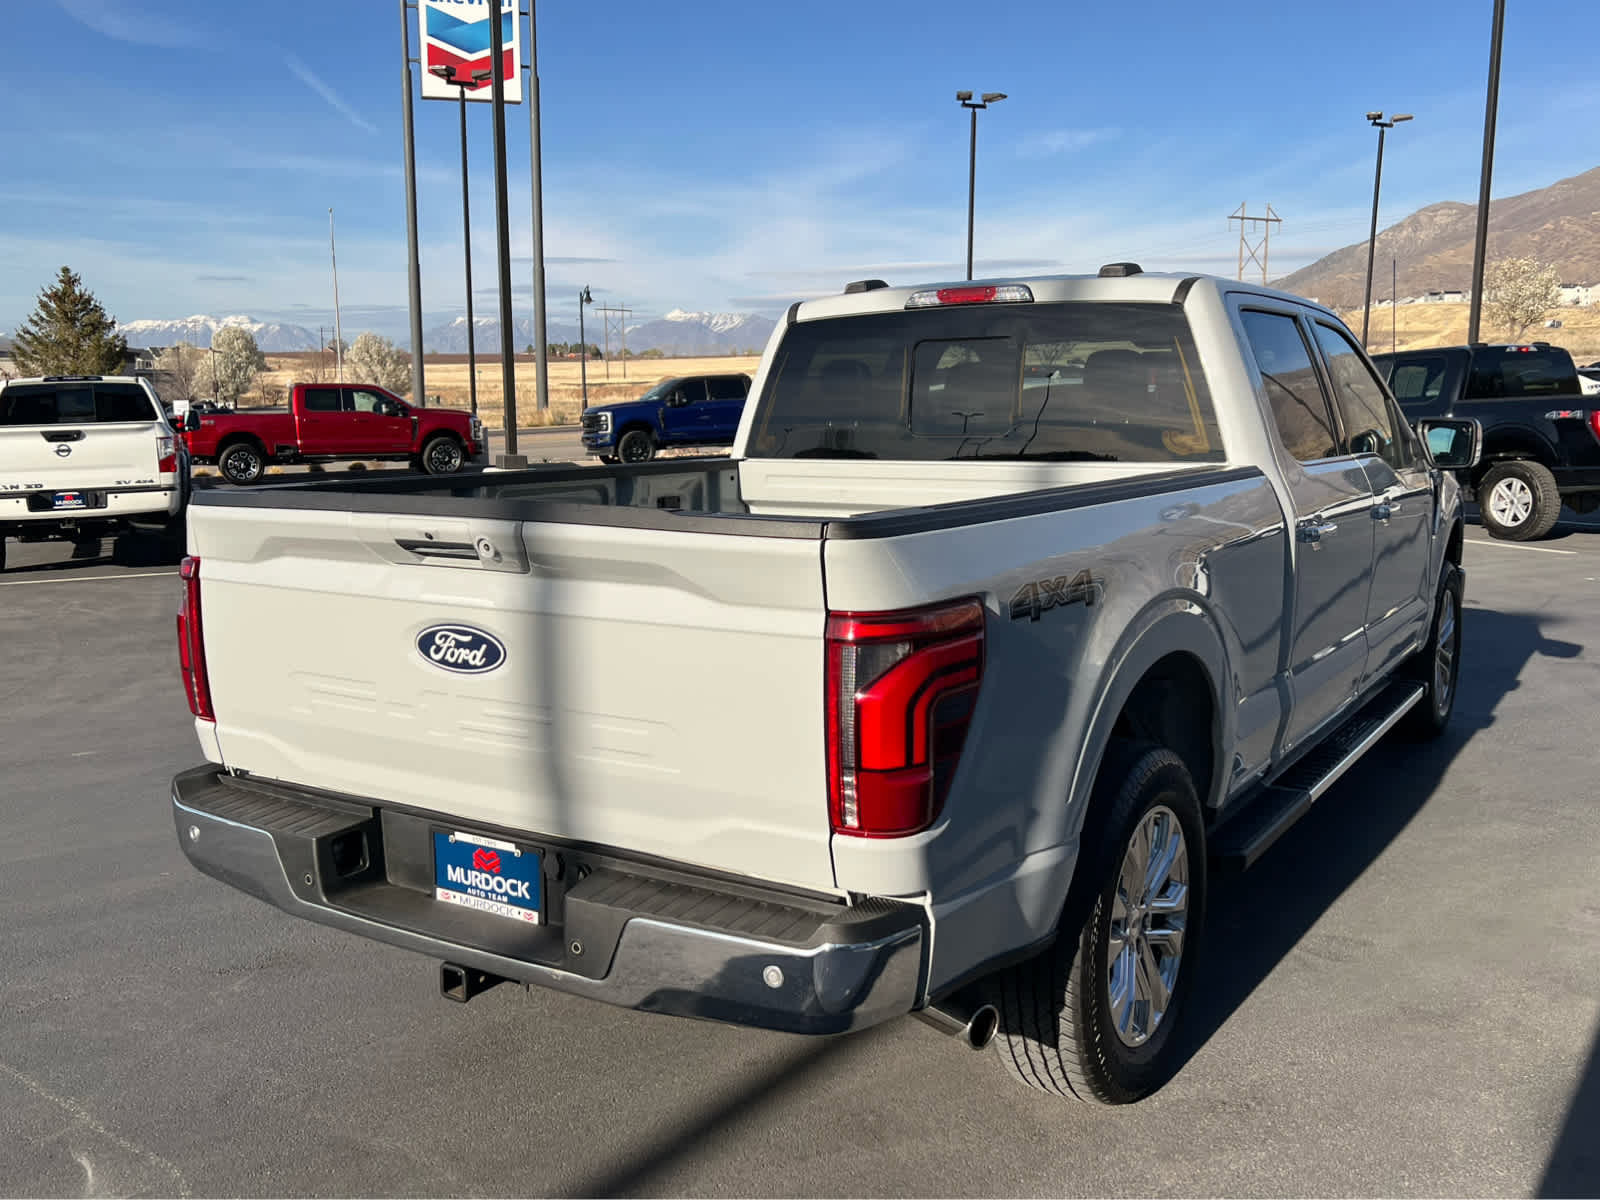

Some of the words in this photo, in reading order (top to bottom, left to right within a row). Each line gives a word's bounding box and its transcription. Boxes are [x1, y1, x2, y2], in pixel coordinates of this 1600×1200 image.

[430, 630, 487, 666] Ford
[447, 864, 530, 900] MURDOCK
[466, 887, 486, 898] AUTO
[488, 892, 508, 903] TEAM
[459, 895, 515, 917] MURDOCK
